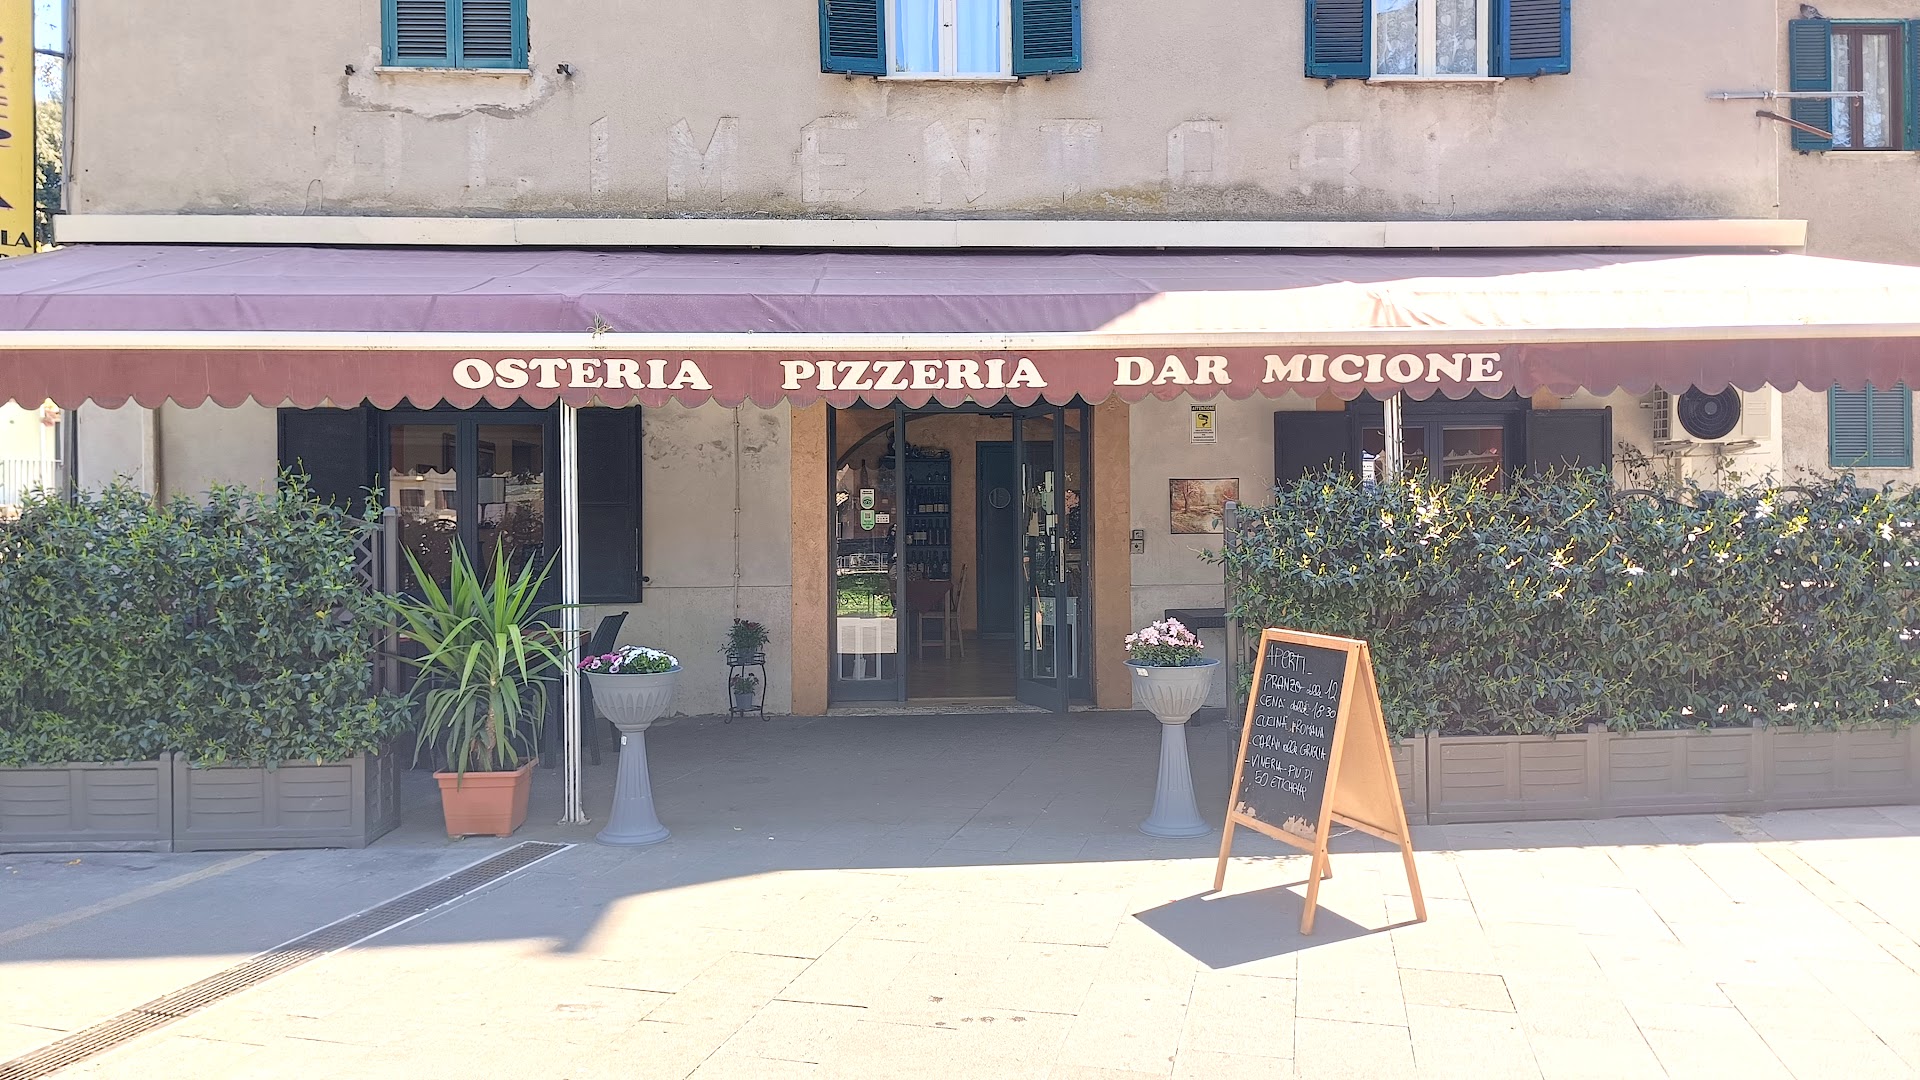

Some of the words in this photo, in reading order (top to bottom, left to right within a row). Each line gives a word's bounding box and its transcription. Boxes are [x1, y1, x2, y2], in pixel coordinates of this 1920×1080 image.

[452, 357, 713, 392] OSTERIA
[779, 356, 1048, 391] PIZZERIA
[1113, 355, 1232, 386] DAR
[1262, 352, 1503, 385] MICIONE
[1266, 644, 1306, 675] APERTI
[1324, 679, 1338, 702] 12
[1255, 770, 1269, 787] 50
